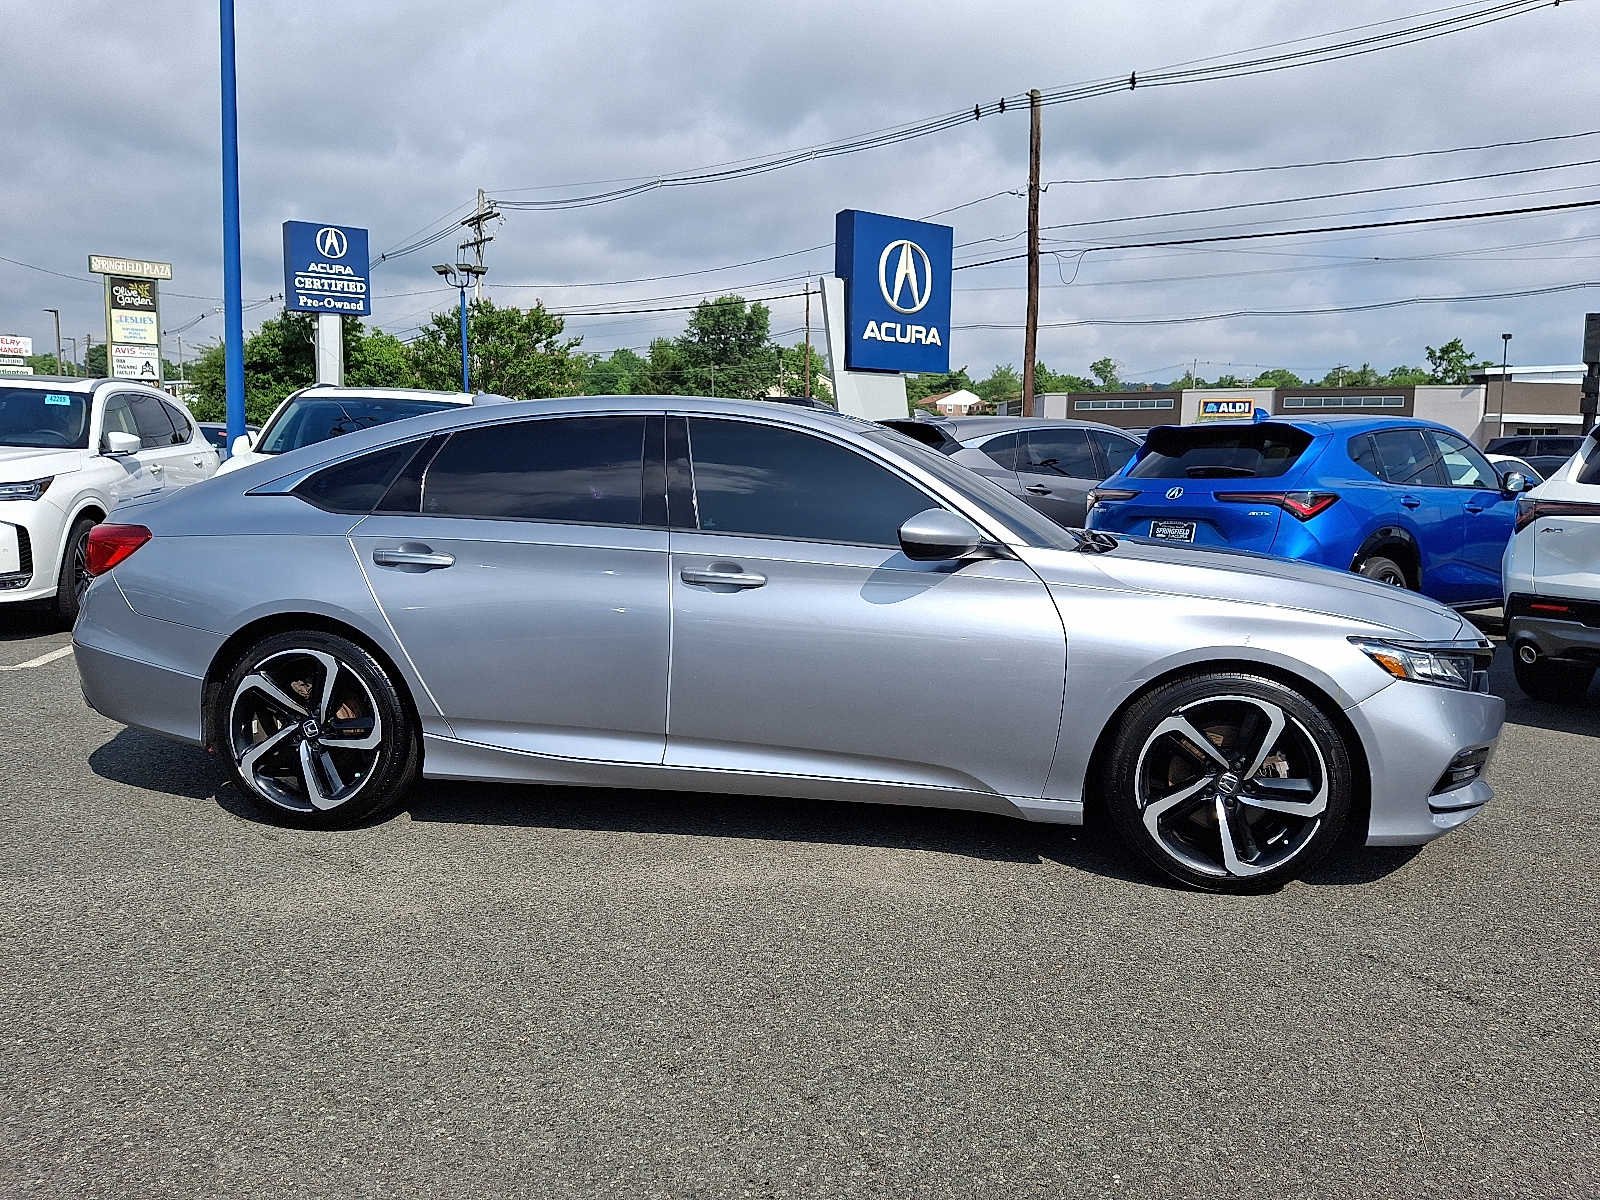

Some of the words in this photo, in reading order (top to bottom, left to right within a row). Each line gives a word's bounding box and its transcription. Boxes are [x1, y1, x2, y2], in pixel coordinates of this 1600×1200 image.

[91, 257, 142, 273] SPRINGFIELD
[143, 262, 171, 276] PLAZA
[308, 262, 354, 276] ACURA
[112, 286, 139, 297] Olive
[294, 277, 366, 293] CERTIFIED
[116, 295, 153, 306] Garden
[298, 295, 364, 310] Pre-Owned
[862, 320, 942, 347] ACURA
[114, 346, 136, 355] AVIS
[1218, 402, 1250, 413] ALDI
